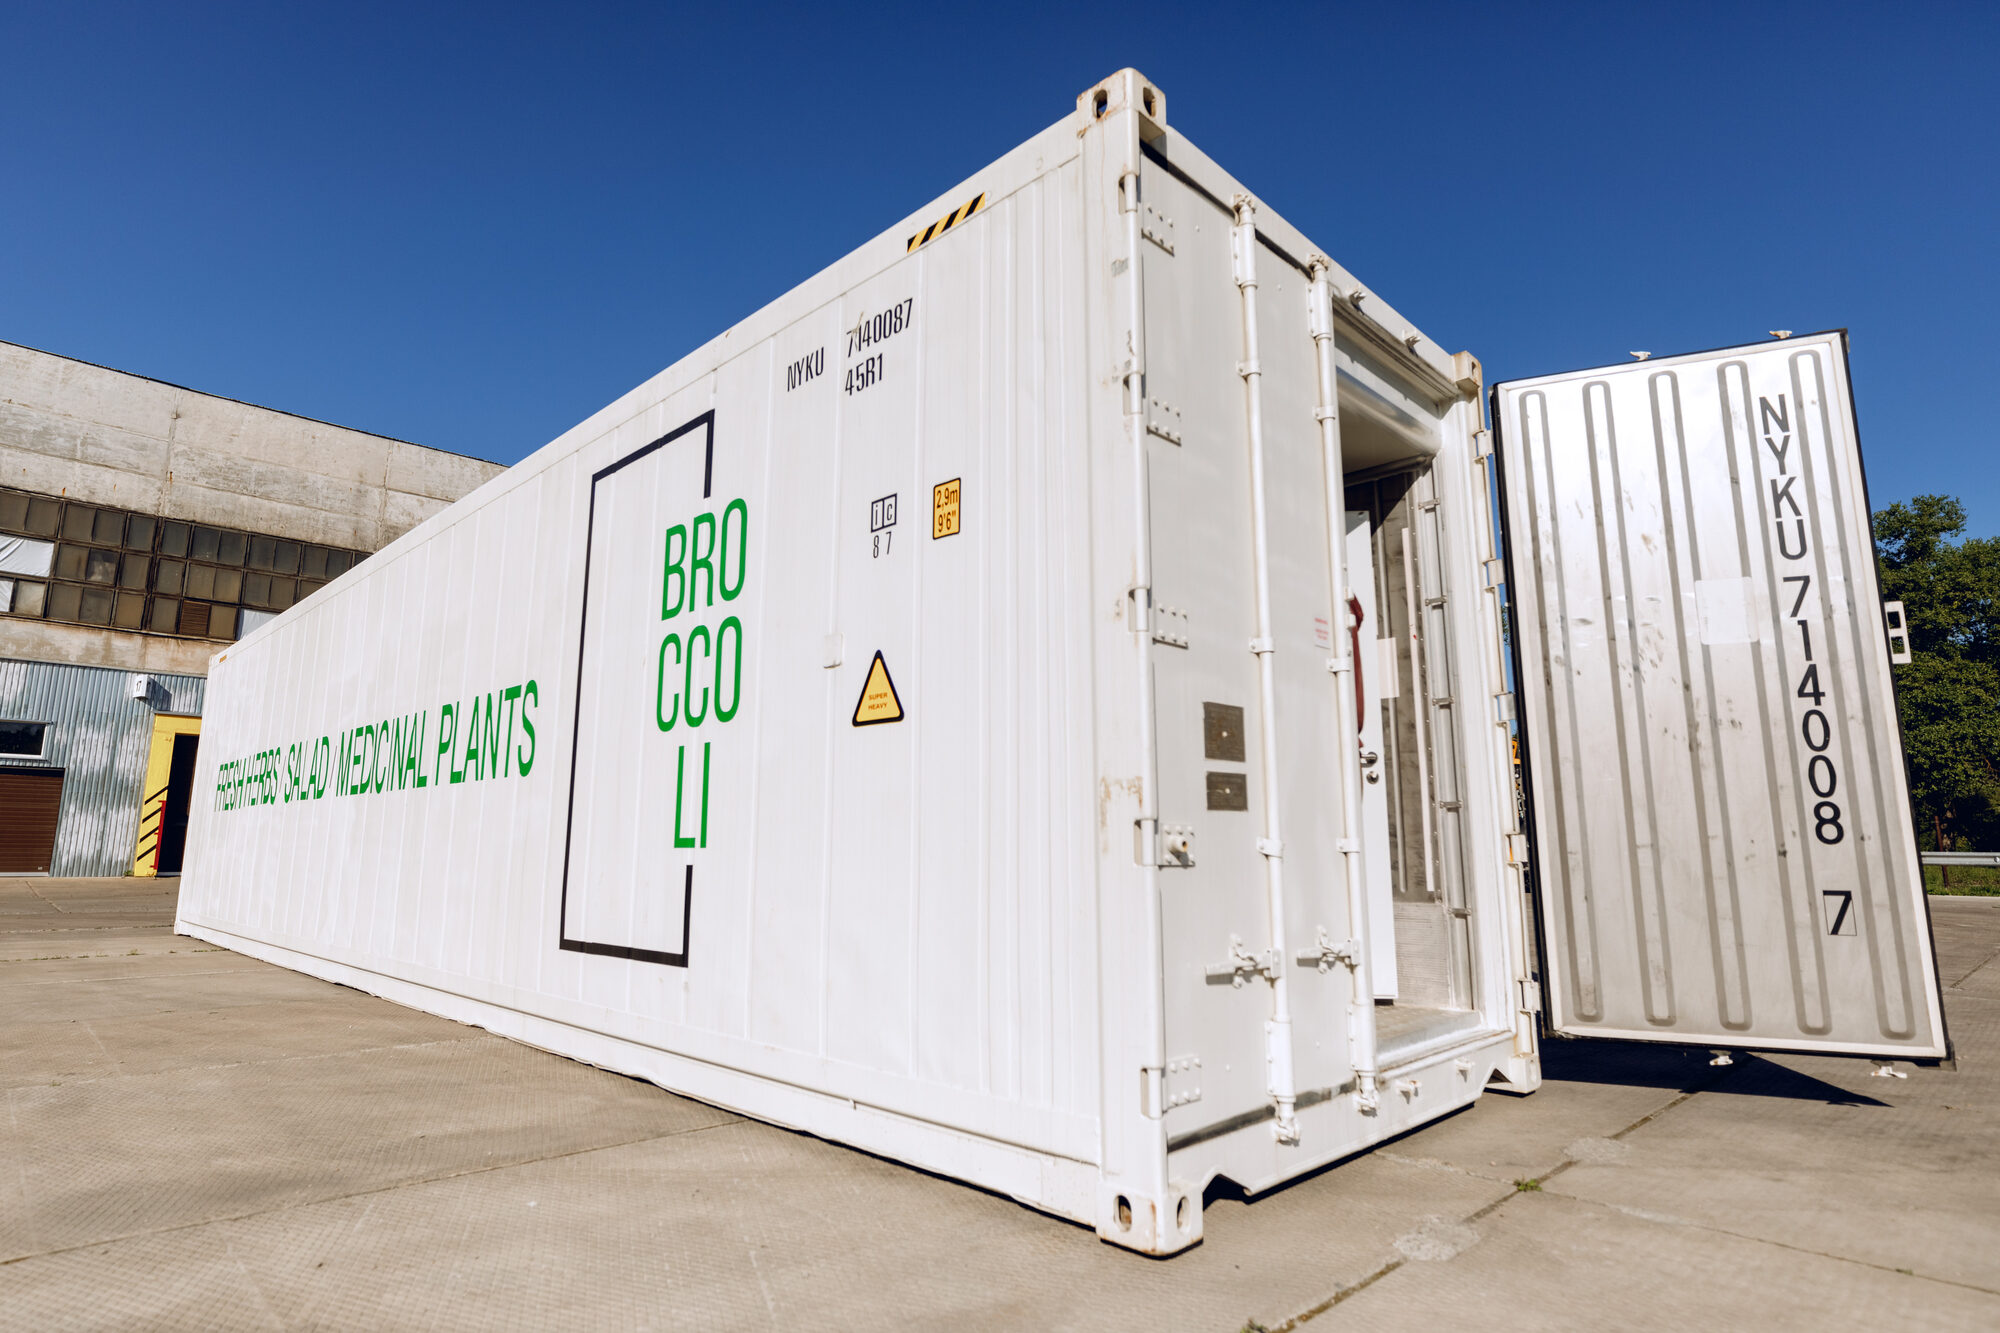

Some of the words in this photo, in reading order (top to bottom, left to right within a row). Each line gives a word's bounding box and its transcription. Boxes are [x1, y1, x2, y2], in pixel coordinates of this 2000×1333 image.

[787, 347, 825, 392] NYKU
[846, 297, 913, 358] 7140087
[845, 353, 883, 396] 45R1
[661, 498, 748, 621] BRO
[656, 616, 743, 732] CCO
[868, 692, 888, 700] SUPER
[868, 702, 888, 710] HEAVY
[1759, 394, 1807, 560] NYKU
[1823, 890, 1853, 935] 7
[214, 757, 247, 812] FRESH
[243, 746, 280, 806] HERBS
[284, 736, 330, 804] SALAD
[336, 710, 427, 797] MEDICINAL
[435, 680, 539, 787] PLANTS
[674, 742, 711, 848] LI
